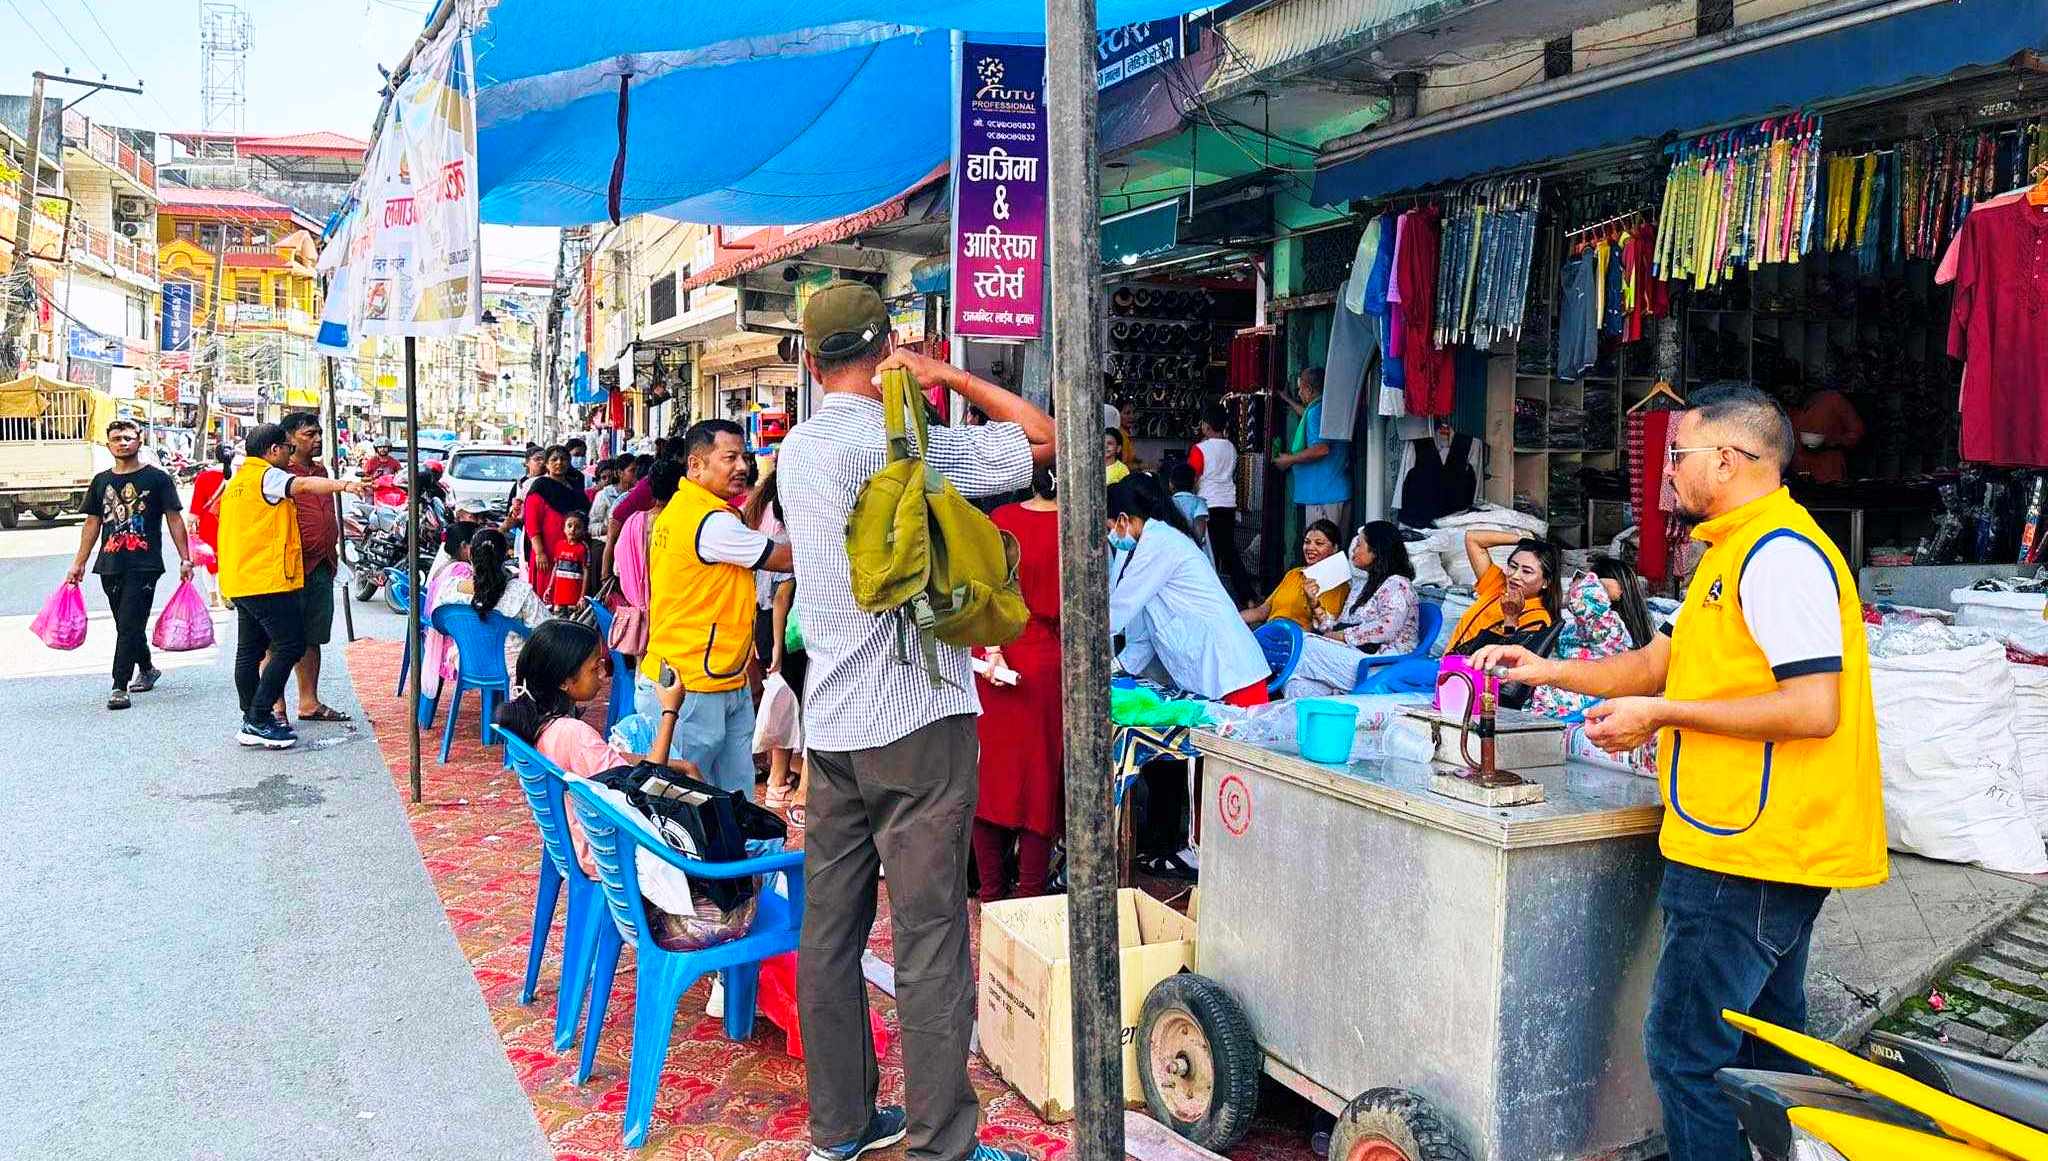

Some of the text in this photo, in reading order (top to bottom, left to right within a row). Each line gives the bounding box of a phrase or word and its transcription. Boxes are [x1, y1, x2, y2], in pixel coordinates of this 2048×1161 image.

[972, 100, 1036, 111] PROFESSIONAL
[989, 88, 1035, 101] TUTU
[967, 146, 1040, 182] हाजिमा
[993, 184, 1010, 220] &
[963, 225, 1038, 261] आरिस्फा
[973, 264, 1025, 300] स्टोर्स
[1121, 1025, 1138, 1046] er
[1870, 1042, 1905, 1063] ONDA
